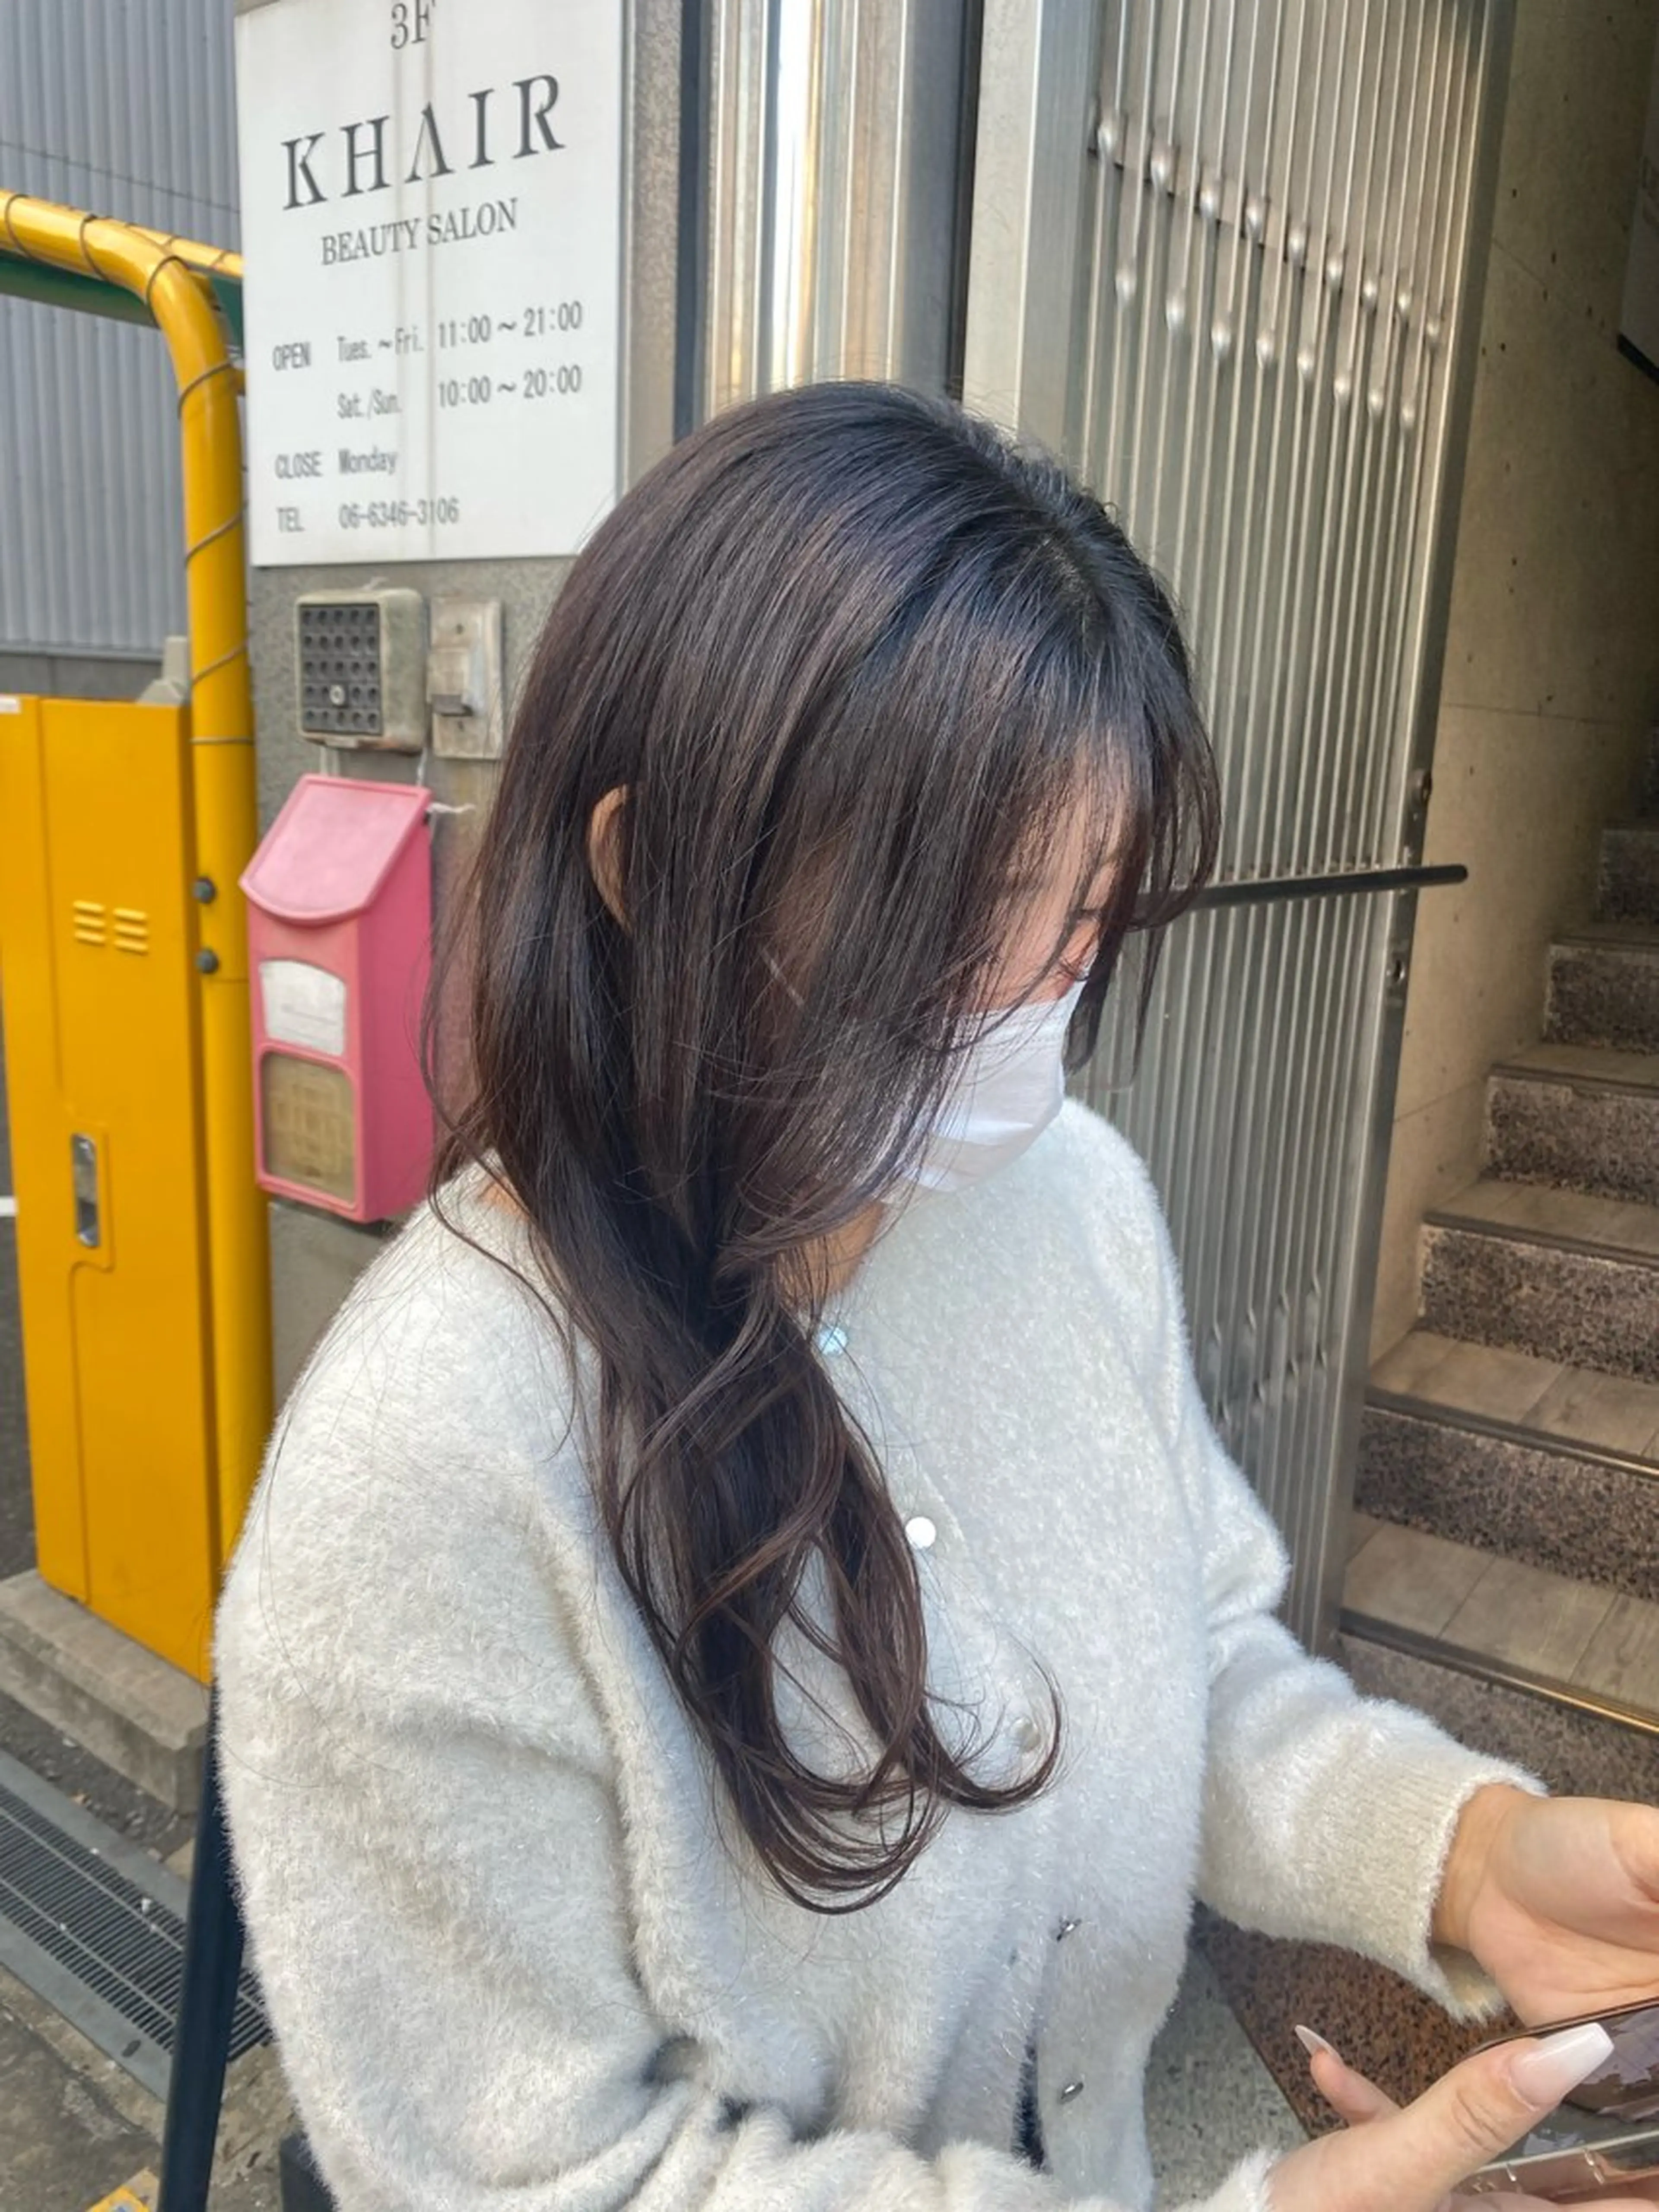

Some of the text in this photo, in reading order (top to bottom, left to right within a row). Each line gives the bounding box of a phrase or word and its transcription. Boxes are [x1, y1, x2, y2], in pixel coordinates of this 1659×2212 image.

[390, 0, 435, 50] 3F
[321, 198, 518, 266] BEAUTY SALON
[273, 341, 311, 371] OPEN
[275, 445, 397, 479] CLOSE Monday
[277, 507, 305, 532] TEL
